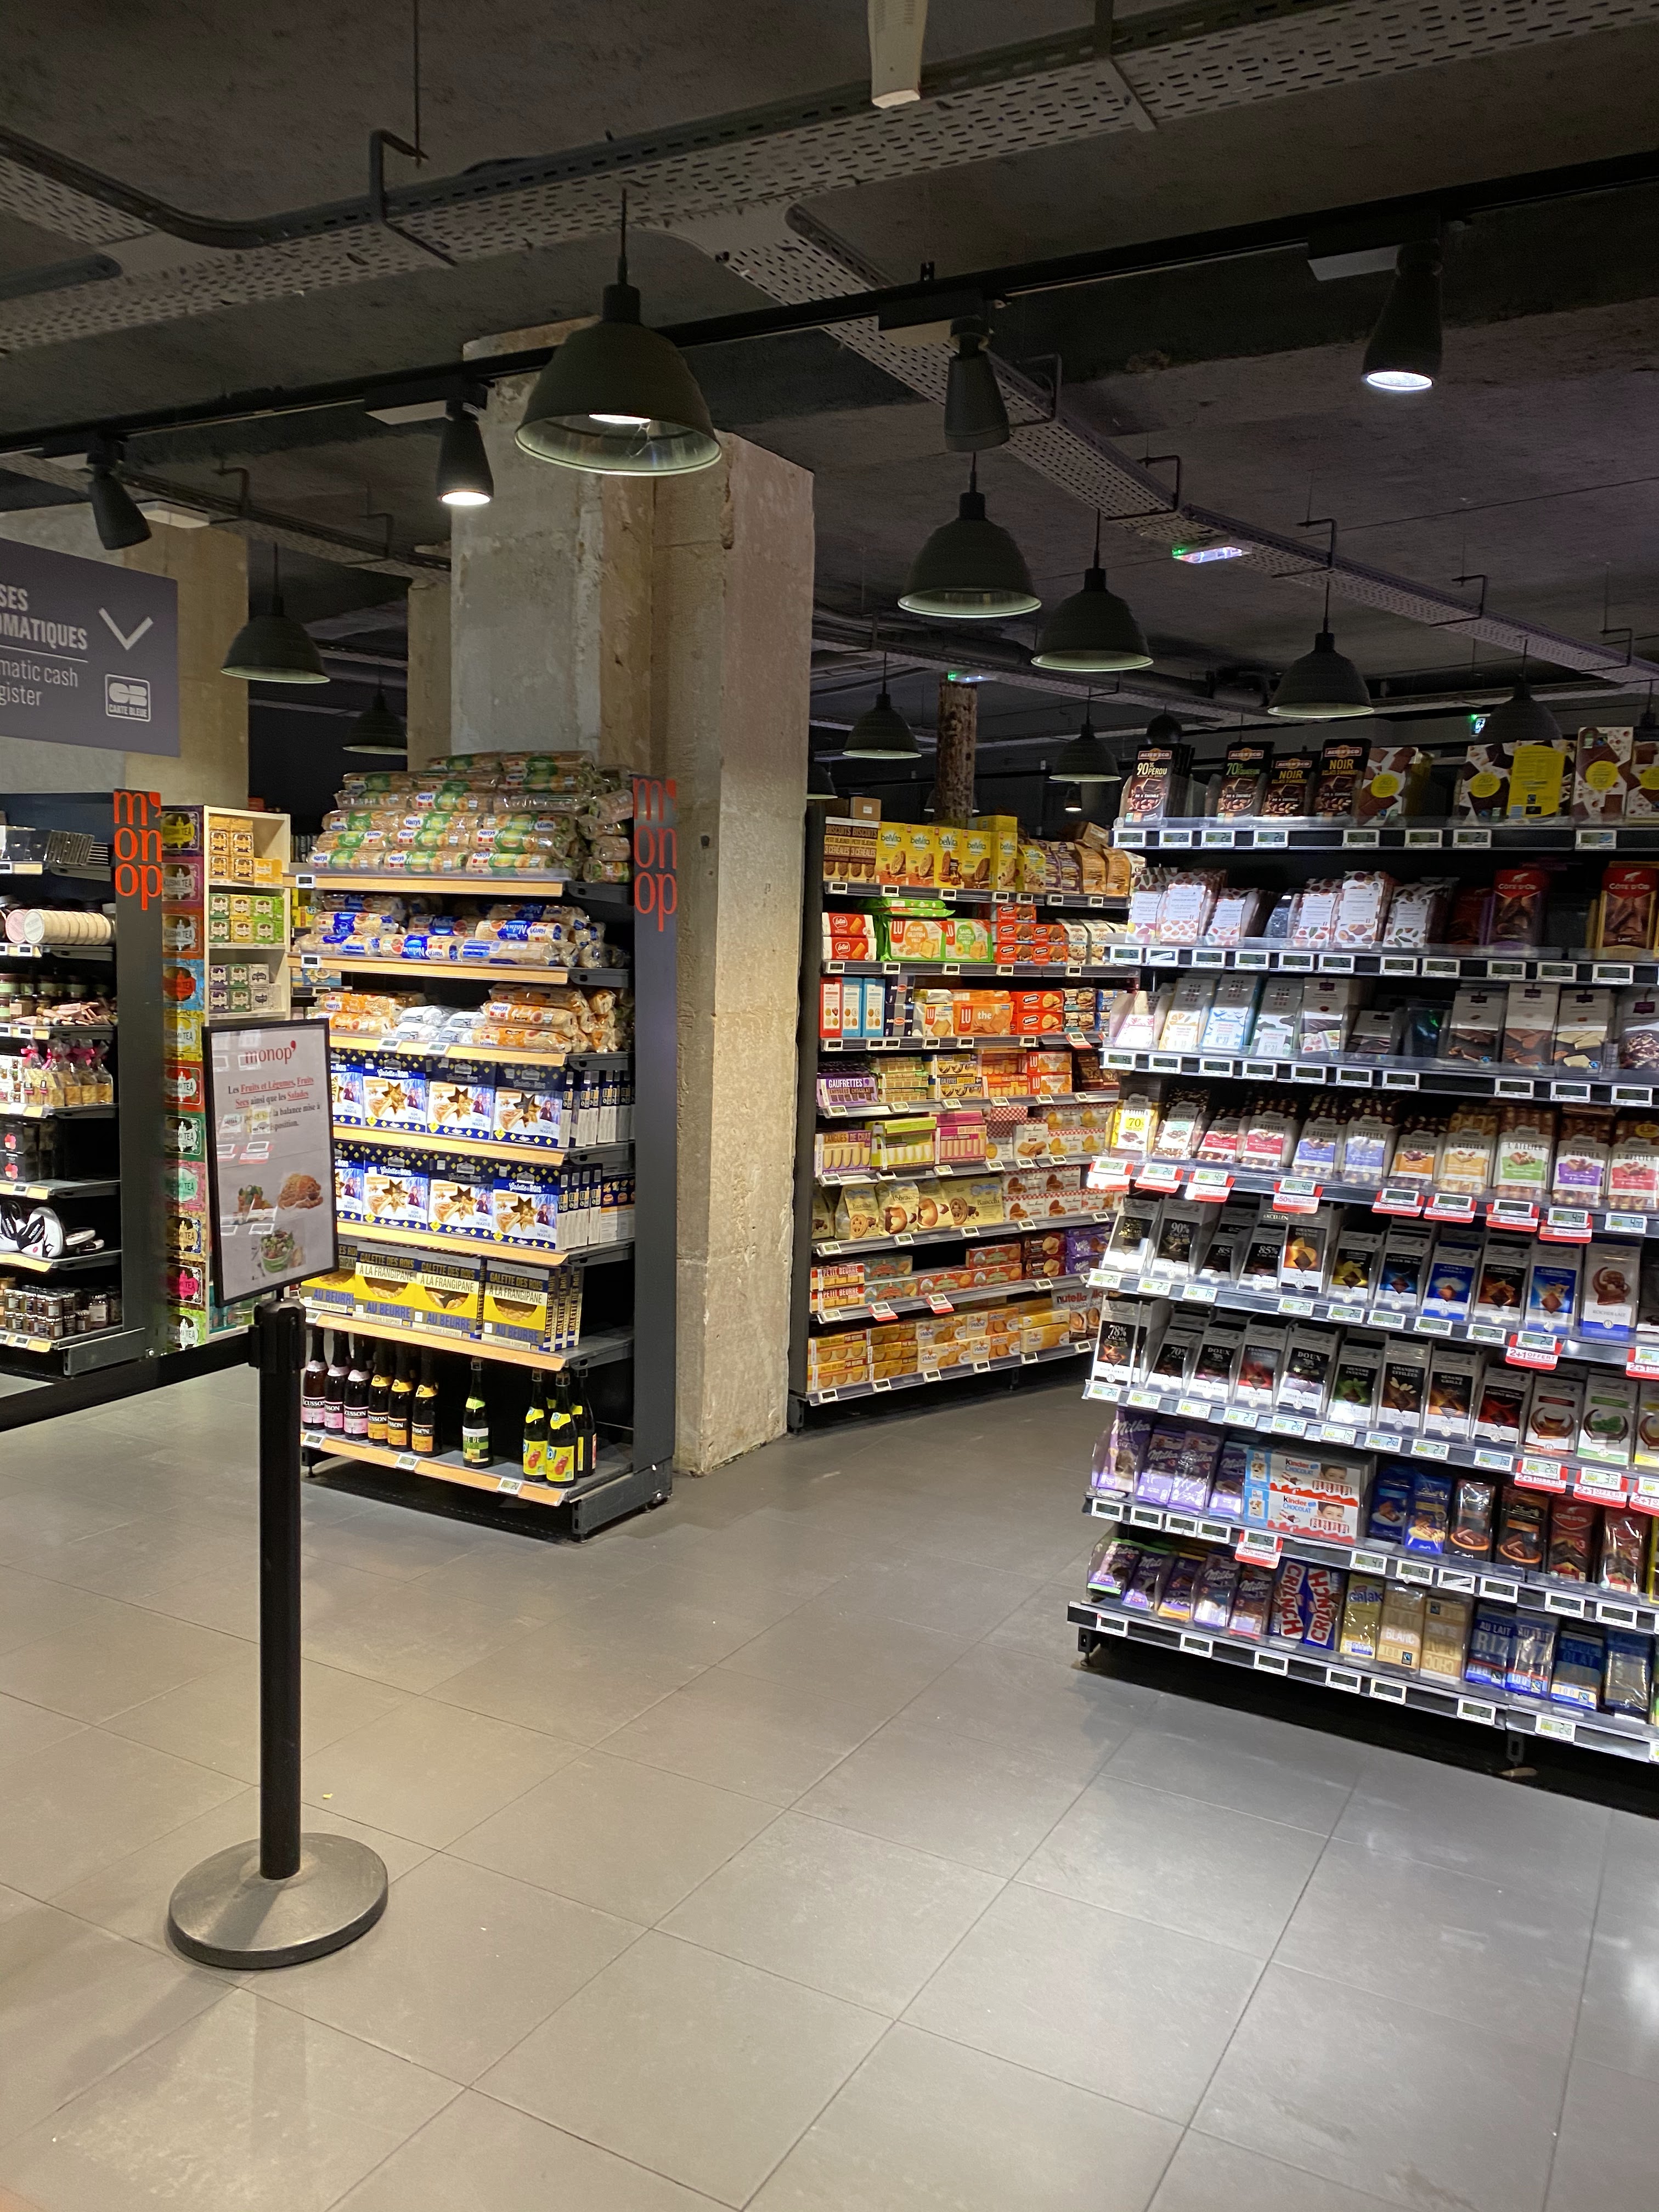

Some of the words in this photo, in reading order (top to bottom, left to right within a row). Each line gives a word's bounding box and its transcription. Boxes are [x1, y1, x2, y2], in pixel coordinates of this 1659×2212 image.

[0, 612, 88, 650] MATIQUES
[44, 667, 78, 687] cash
[109, 704, 128, 715] CARTE
[129, 707, 147, 718] BLEUE
[1329, 758, 1354, 770] NOIR
[1148, 765, 1167, 776] PÉROU
[1279, 769, 1304, 780] NOIR
[182, 827, 191, 836] TEA
[826, 825, 850, 836] BISCUITS
[853, 826, 877, 838] BISCUITS
[881, 833, 902, 843] belVita
[910, 836, 930, 845] belVita
[938, 834, 958, 847] belVita
[114, 827, 162, 862] on
[634, 825, 677, 870] on
[824, 845, 828, 854] 3
[828, 845, 850, 855] CÉRÉALES
[967, 840, 986, 850] belVita
[851, 847, 855, 855] 3
[855, 847, 876, 857] CÉRÉALES
[115, 862, 163, 911] op
[182, 879, 193, 888] TEA
[634, 872, 678, 932] op
[834, 917, 847, 926] Lotus
[894, 921, 902, 934] LU
[182, 929, 193, 939] TEA
[504, 924, 527, 935] Nature
[403, 946, 425, 956] Nature
[927, 1008, 934, 1019] LU
[961, 1009, 971, 1024] LU
[183, 1032, 194, 1042] TEA
[1030, 1056, 1037, 1068] LU
[183, 1082, 194, 1091] TEA
[228, 1086, 239, 1095] Les
[241, 1083, 259, 1093] Fruits
[297, 1076, 314, 1085] Fruits
[828, 1079, 863, 1089] GAUFRETTES
[1032, 1075, 1040, 1089] LU
[235, 1098, 249, 1108] Secs
[251, 1095, 265, 1105] ainsi
[266, 1094, 277, 1105] que
[278, 1093, 286, 1101] les
[287, 1090, 309, 1099] Salades
[280, 1107, 302, 1116] balance
[303, 1104, 316, 1114] mise
[184, 1132, 194, 1142] TEA
[825, 1133, 847, 1143] LANGUES
[850, 1132, 856, 1142] DE
[858, 1131, 871, 1142] CHAT
[184, 1182, 194, 1190] TEA
[509, 1182, 527, 1191] Galette
[1171, 1222, 1190, 1234] 90%
[185, 1231, 195, 1240] TEA
[1259, 1245, 1278, 1255] 85%
[360, 1253, 385, 1265] GALETTE
[386, 1256, 398, 1266] DES
[399, 1257, 414, 1269] ROIS
[365, 1265, 373, 1276] LA
[374, 1266, 413, 1281] FRANGIPANE
[421, 1262, 448, 1274] GALETTE
[449, 1267, 460, 1276] DES
[461, 1268, 475, 1280] ROIS
[823, 1267, 838, 1277] PETIT
[839, 1265, 859, 1276] BEURRE
[185, 1280, 195, 1291] TEA
[426, 1275, 434, 1285] LA
[435, 1276, 474, 1293] FRANGIPANE
[490, 1271, 515, 1285] GALETTE
[516, 1275, 528, 1288] DES
[529, 1278, 543, 1290] ROIS
[314, 1289, 323, 1300] AU
[495, 1288, 503, 1296] LA
[504, 1288, 542, 1304] FRANGIPANE
[823, 1289, 839, 1299] PETIT
[839, 1286, 860, 1297] BEURRE
[1057, 1293, 1088, 1304] nutella
[367, 1301, 377, 1313] AU
[380, 1303, 411, 1319] BEURRE
[476, 1297, 484, 1325] GALETTE
[427, 1312, 437, 1324] AU
[440, 1313, 471, 1331] BEURRE
[544, 1308, 553, 1338] GALETTE
[556, 1305, 565, 1334] GALETTE
[185, 1330, 196, 1340] TEA
[495, 1324, 506, 1335] AU
[507, 1327, 539, 1344] BEURRE
[1109, 1324, 1127, 1337] 78%
[1207, 1347, 1231, 1356] DOUX
[1297, 1351, 1322, 1362] DOUX
[1510, 1348, 1527, 1359] 2+1
[1528, 1352, 1555, 1361] OFFERT
[1111, 1418, 1151, 1436] Milka
[1147, 1449, 1178, 1461] Milka
[1285, 1458, 1310, 1469] kinder
[1285, 1465, 1314, 1475] CHOCOLAT
[1518, 1474, 1536, 1483] 2+1
[1577, 1485, 1594, 1495] 2+1
[1595, 1489, 1624, 1499] OFFERT
[1283, 1495, 1307, 1507] kinder
[1634, 1494, 1651, 1504] 2+1
[1283, 1502, 1312, 1514] CHOCOLAT
[1205, 1570, 1236, 1580] Milka
[1281, 1565, 1304, 1636] CRUNCH
[1349, 1591, 1383, 1604] Galak
[1307, 1570, 1330, 1642] CRUNCH
[1480, 1622, 1492, 1632] AU
[1493, 1624, 1511, 1636] LAIT
[1517, 1627, 1531, 1637] AU
[1385, 1627, 1415, 1645] BLANC
